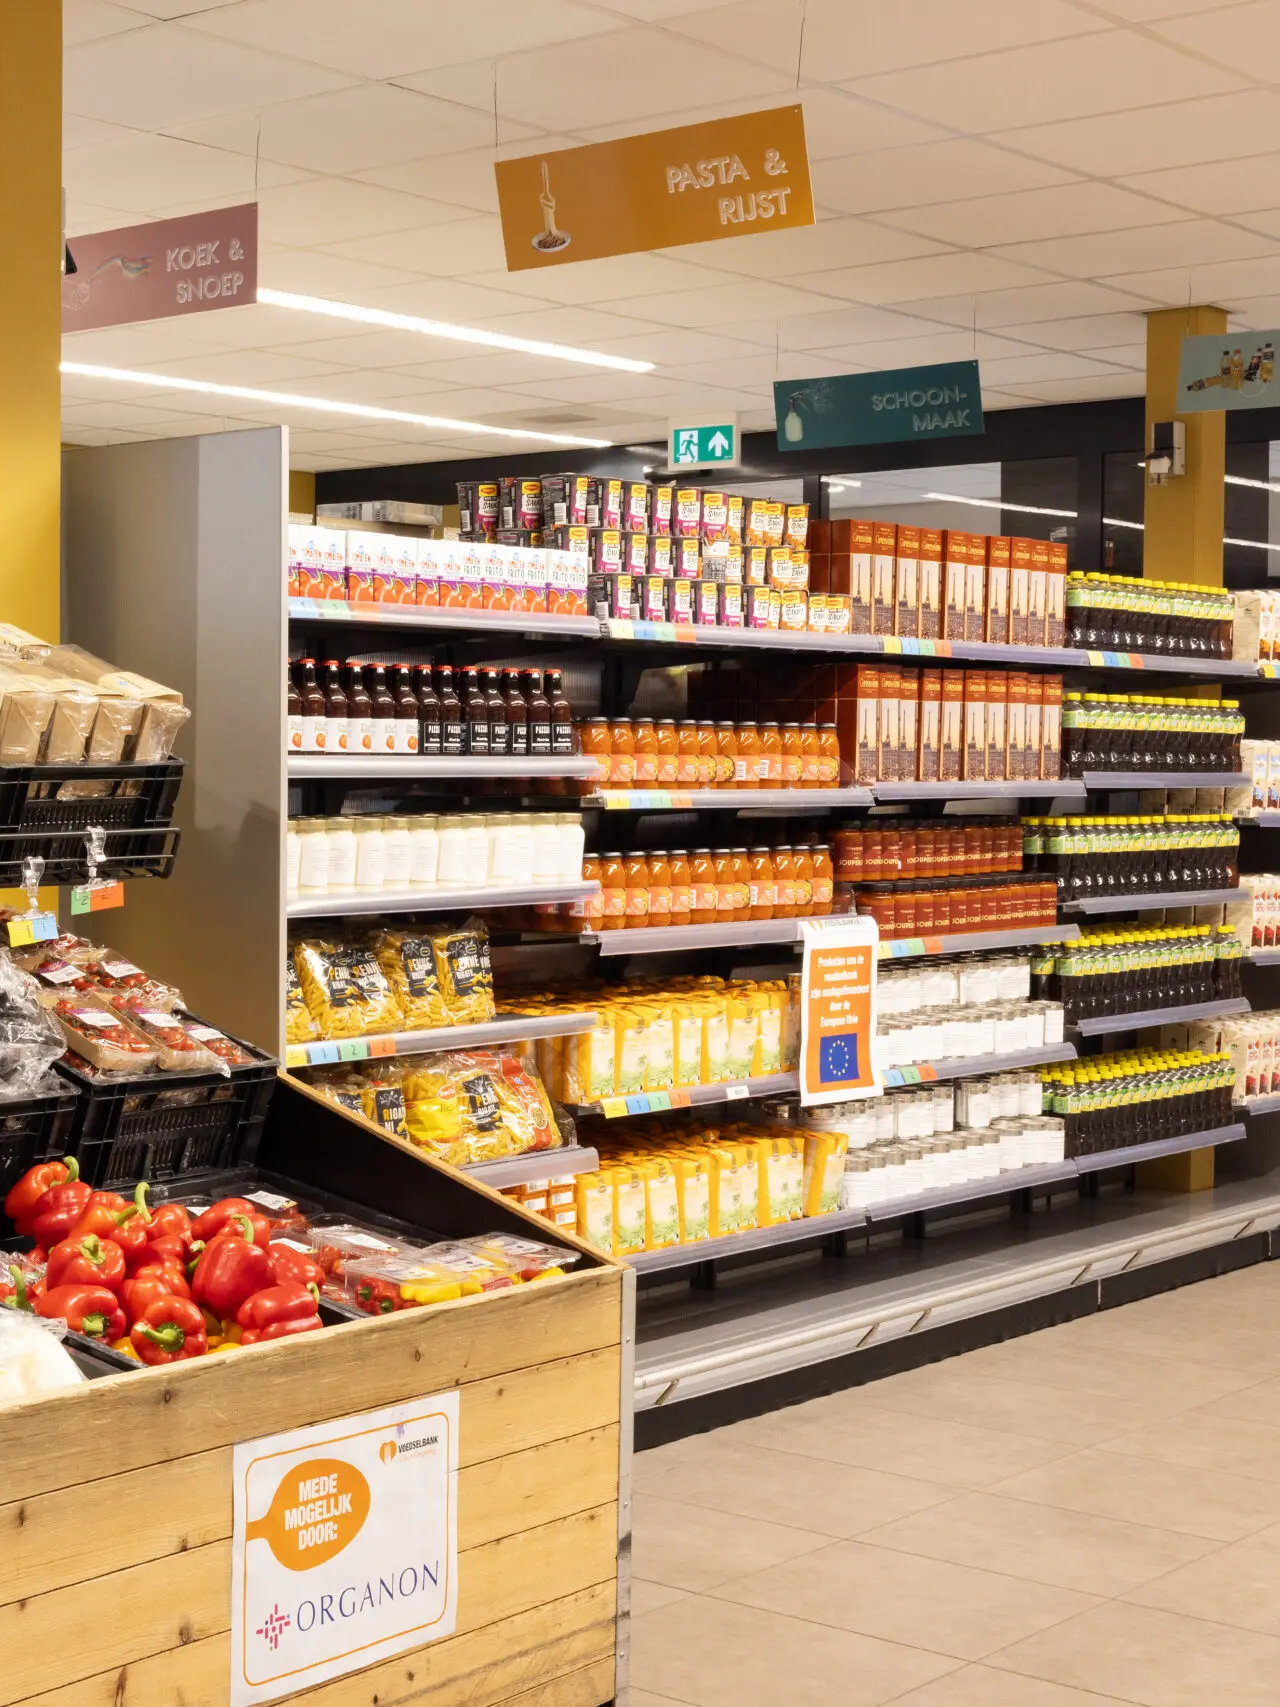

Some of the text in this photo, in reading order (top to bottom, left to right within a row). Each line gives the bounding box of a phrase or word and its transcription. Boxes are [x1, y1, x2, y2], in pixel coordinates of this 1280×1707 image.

[666, 148, 789, 194] PASTA &
[718, 186, 791, 225] RIJST
[165, 238, 245, 272] KOEK &
[176, 271, 244, 304] SNOEP
[871, 385, 968, 412] SCHOON-
[912, 409, 970, 432] MAAK
[350, 1044, 358, 1056] 2
[382, 1041, 388, 1052] 2
[398, 1435, 439, 1454] VOEDSELBANK
[298, 1473, 338, 1502] MEDE
[284, 1493, 352, 1531] MOGELIJK
[297, 1521, 338, 1551] DOOR:
[297, 1559, 440, 1632] ORGANON
